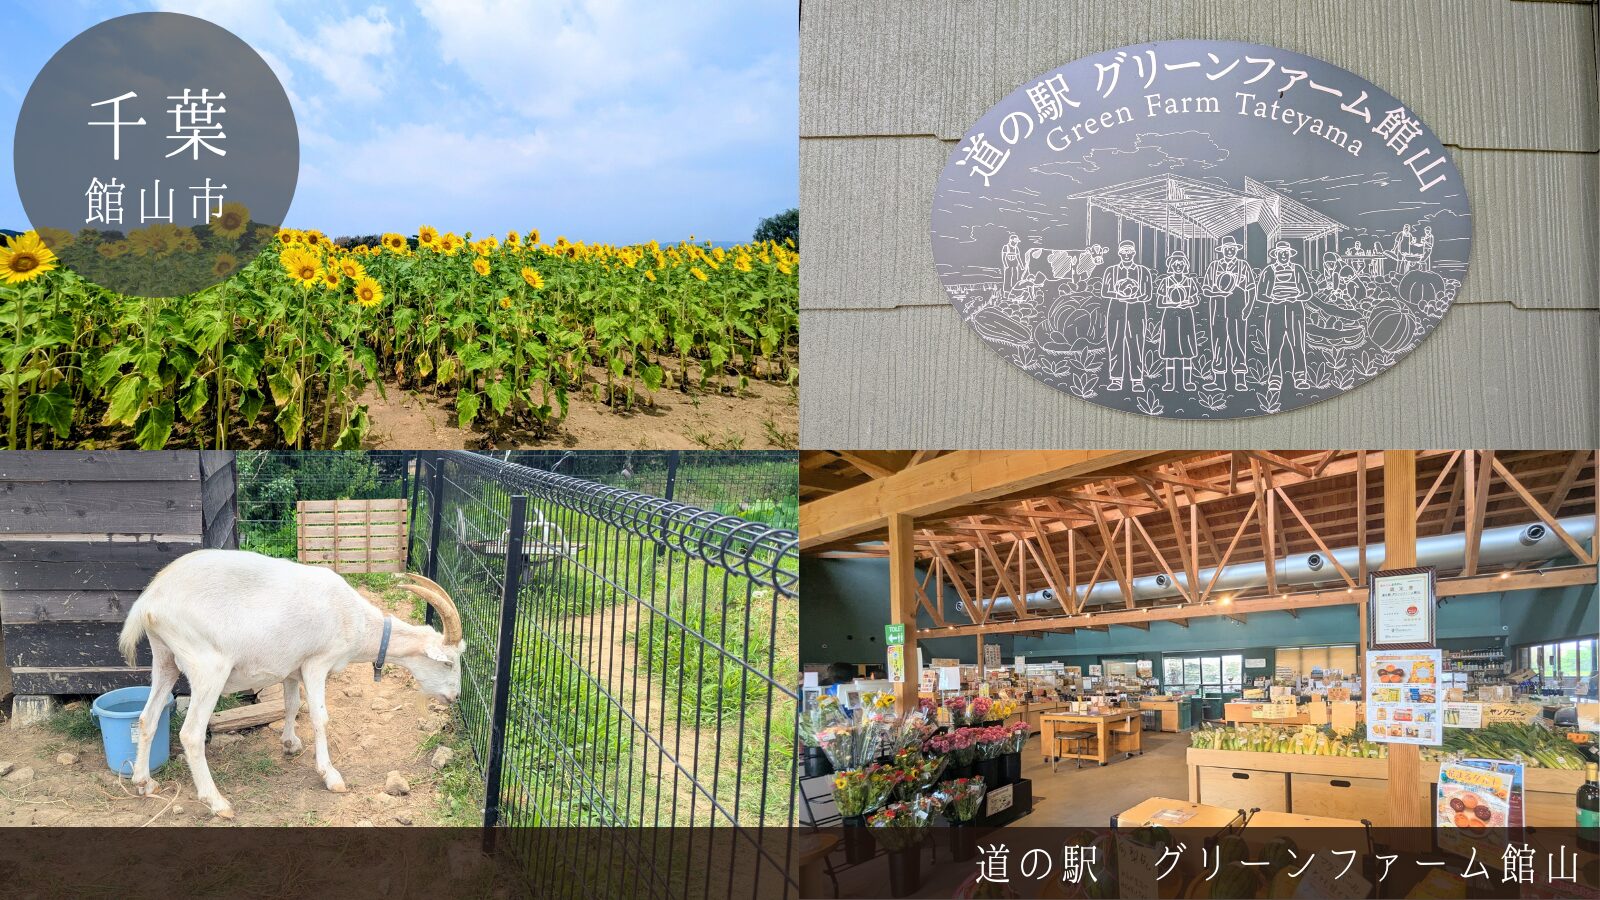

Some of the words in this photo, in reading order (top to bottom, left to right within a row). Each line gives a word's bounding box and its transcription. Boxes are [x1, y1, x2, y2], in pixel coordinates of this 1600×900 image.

[956, 73, 1081, 187] 道の駅
[1092, 49, 1447, 193] グリーンファーム館山
[1046, 106, 1134, 152] Green
[1144, 92, 1221, 118] Farm
[1235, 91, 1363, 157] Tateyama
